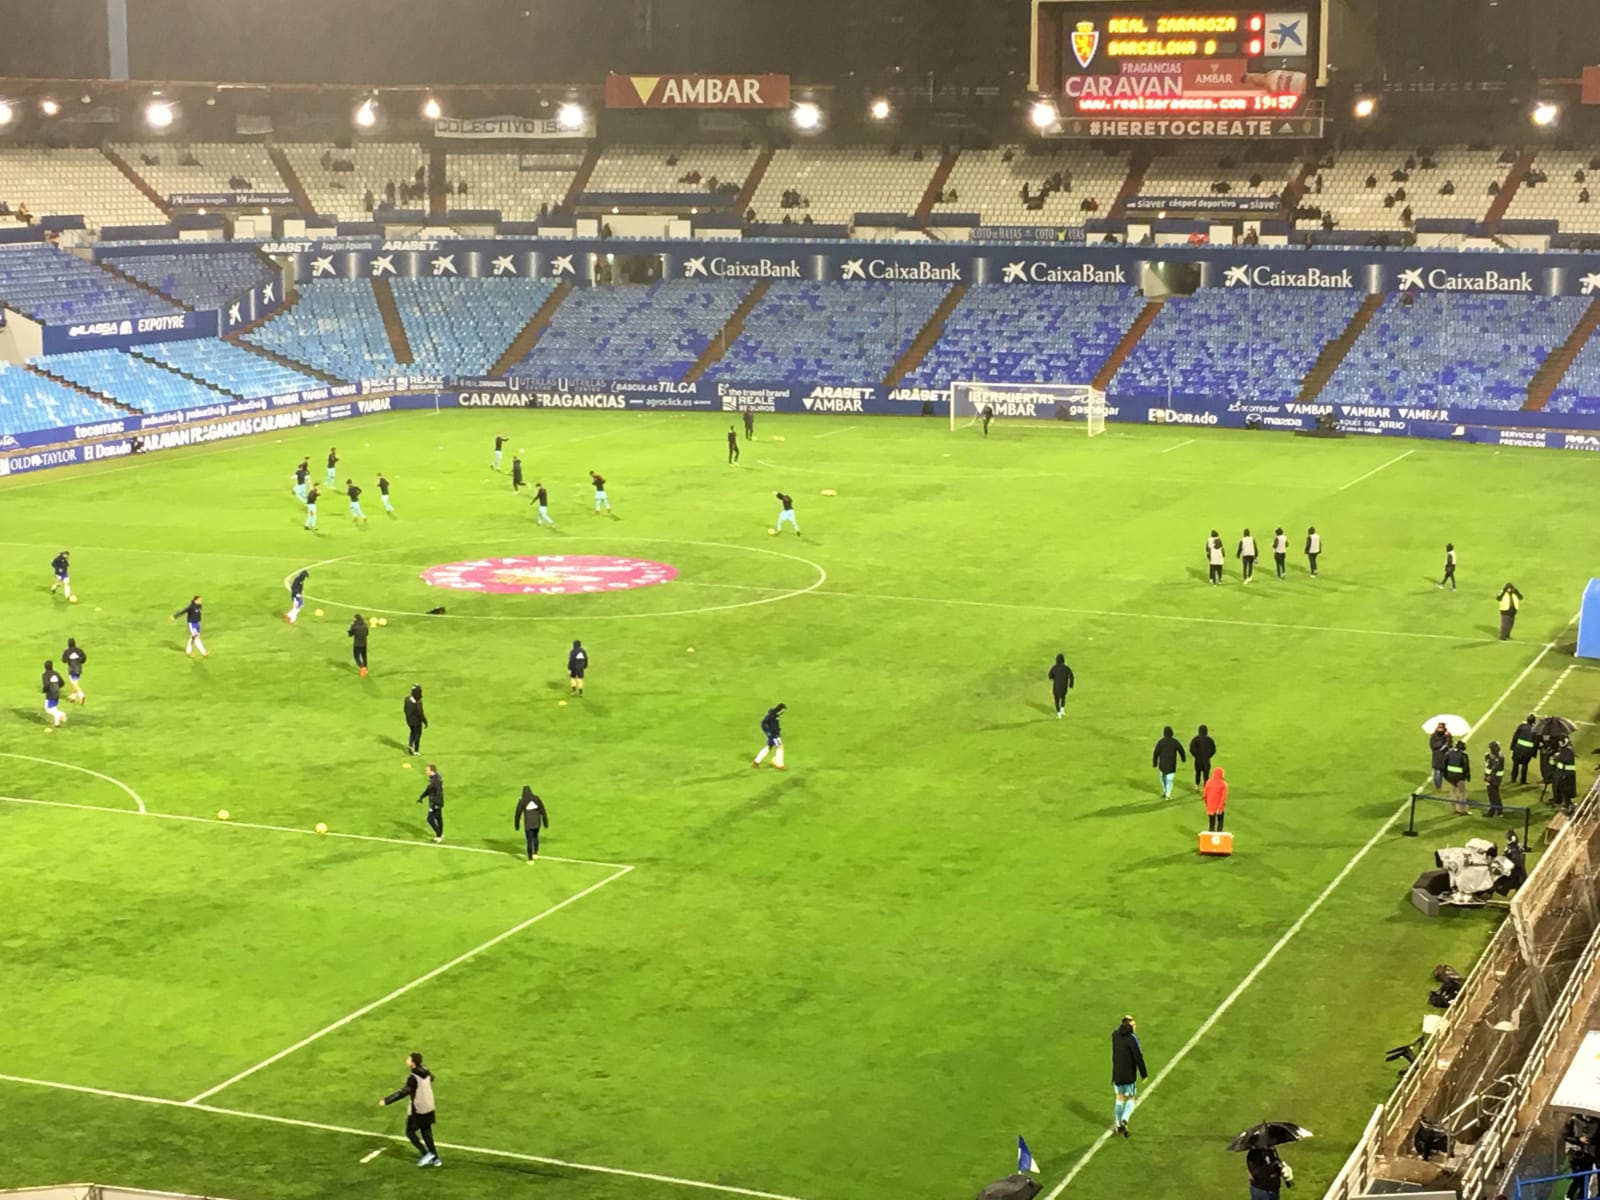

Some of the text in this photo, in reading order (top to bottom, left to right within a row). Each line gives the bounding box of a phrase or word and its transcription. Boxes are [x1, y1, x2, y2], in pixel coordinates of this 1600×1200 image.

[1108, 17, 1148, 33] REAL
[1156, 16, 1237, 33] ZARAGOZA
[1107, 39, 1198, 56] BARCELONA
[1122, 62, 1182, 73] FRAGANCIAS
[1195, 74, 1233, 84] AMBAR
[662, 79, 764, 104] AMBAR
[1065, 76, 1183, 97] CARAVAN
[1079, 95, 1298, 110] www.realzaragoza.com 19:57
[436, 118, 535, 134] COLECTIVO
[1089, 120, 1272, 136] #HERETOCREATE
[1198, 199, 1237, 209] deportivo
[710, 257, 801, 278] CaixaBank
[868, 260, 962, 281] CaixaBank
[1029, 262, 1126, 283] CaixaBank
[1252, 266, 1353, 289] CaixaBank
[1428, 270, 1533, 292] CaixaBank
[138, 315, 185, 332] EXPOTYRE
[410, 376, 444, 384] REALE
[658, 382, 697, 393] TILCA
[743, 388, 766, 396] travel
[766, 388, 790, 397] brand
[811, 387, 874, 399] ARABET
[459, 392, 532, 406] CARAVAN
[646, 398, 693, 407] agroclick.es
[739, 396, 775, 405] REALE
[814, 399, 864, 412] AMBAR
[1294, 404, 1334, 414] AMBAR
[1350, 406, 1390, 418] AMBAR
[1407, 409, 1449, 421] AMBAR
[253, 411, 301, 432] CARAVAN
[1263, 417, 1303, 426] mazda
[1379, 421, 1406, 429] ATRIO
[1500, 431, 1533, 439] SERVICIO
[10, 456, 32, 471] OLD
[42, 449, 77, 466] TAYLOR
[84, 446, 95, 461] El
